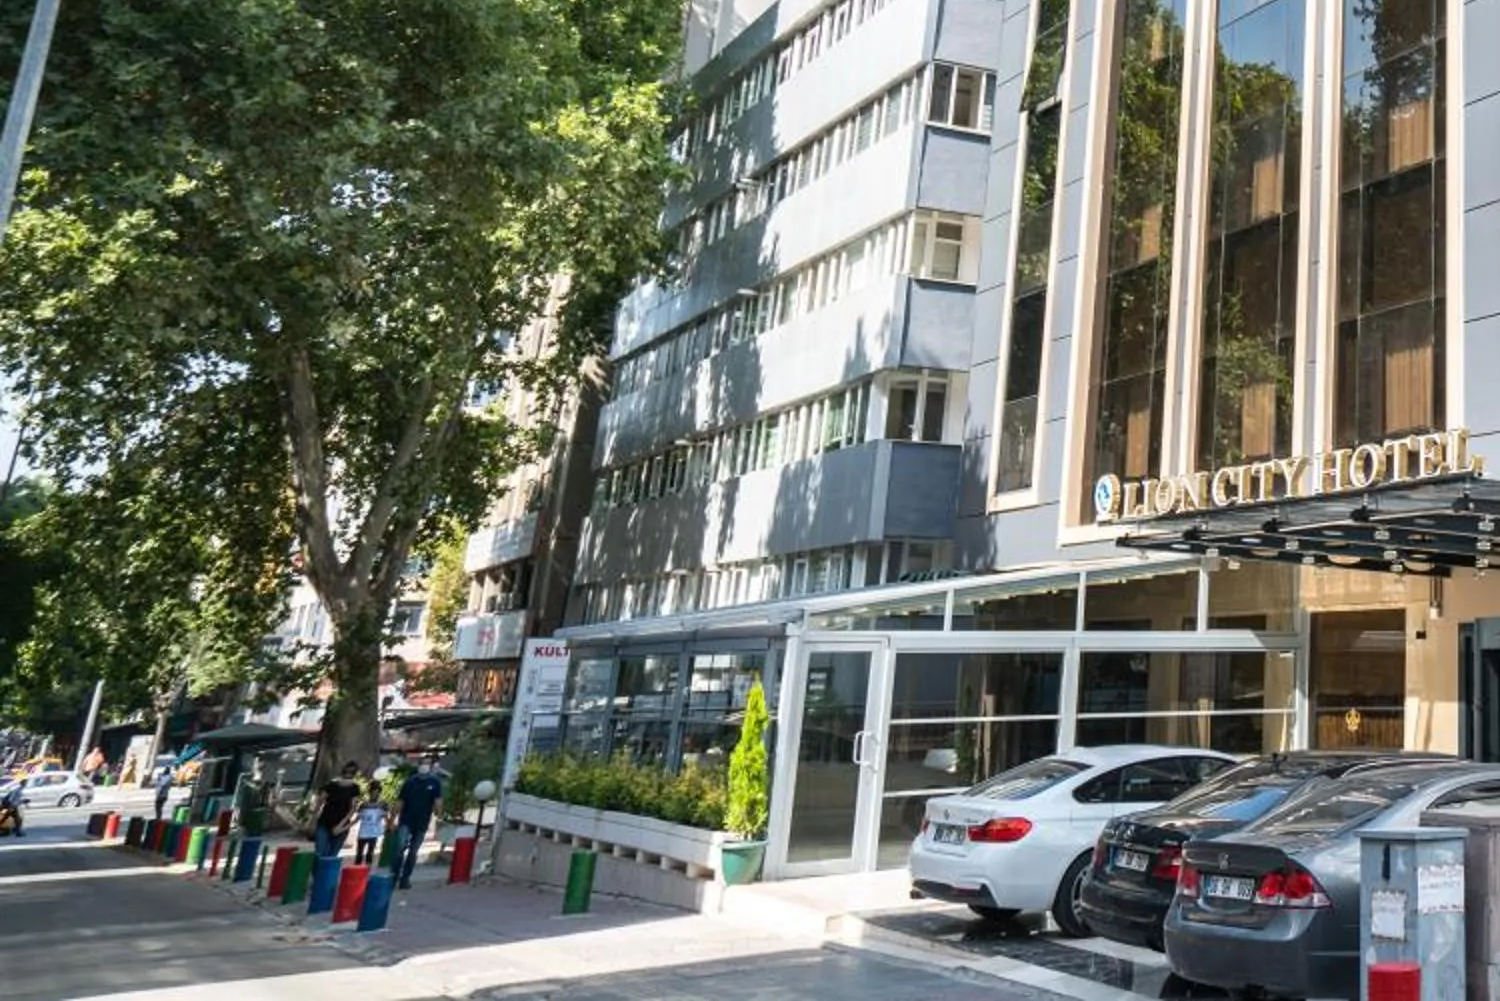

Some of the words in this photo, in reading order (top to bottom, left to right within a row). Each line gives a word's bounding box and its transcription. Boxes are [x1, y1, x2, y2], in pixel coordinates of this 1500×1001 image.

[1122, 472, 1208, 519] LION
[1212, 456, 1307, 507] CITY
[1312, 429, 1483, 497] HOTEL
